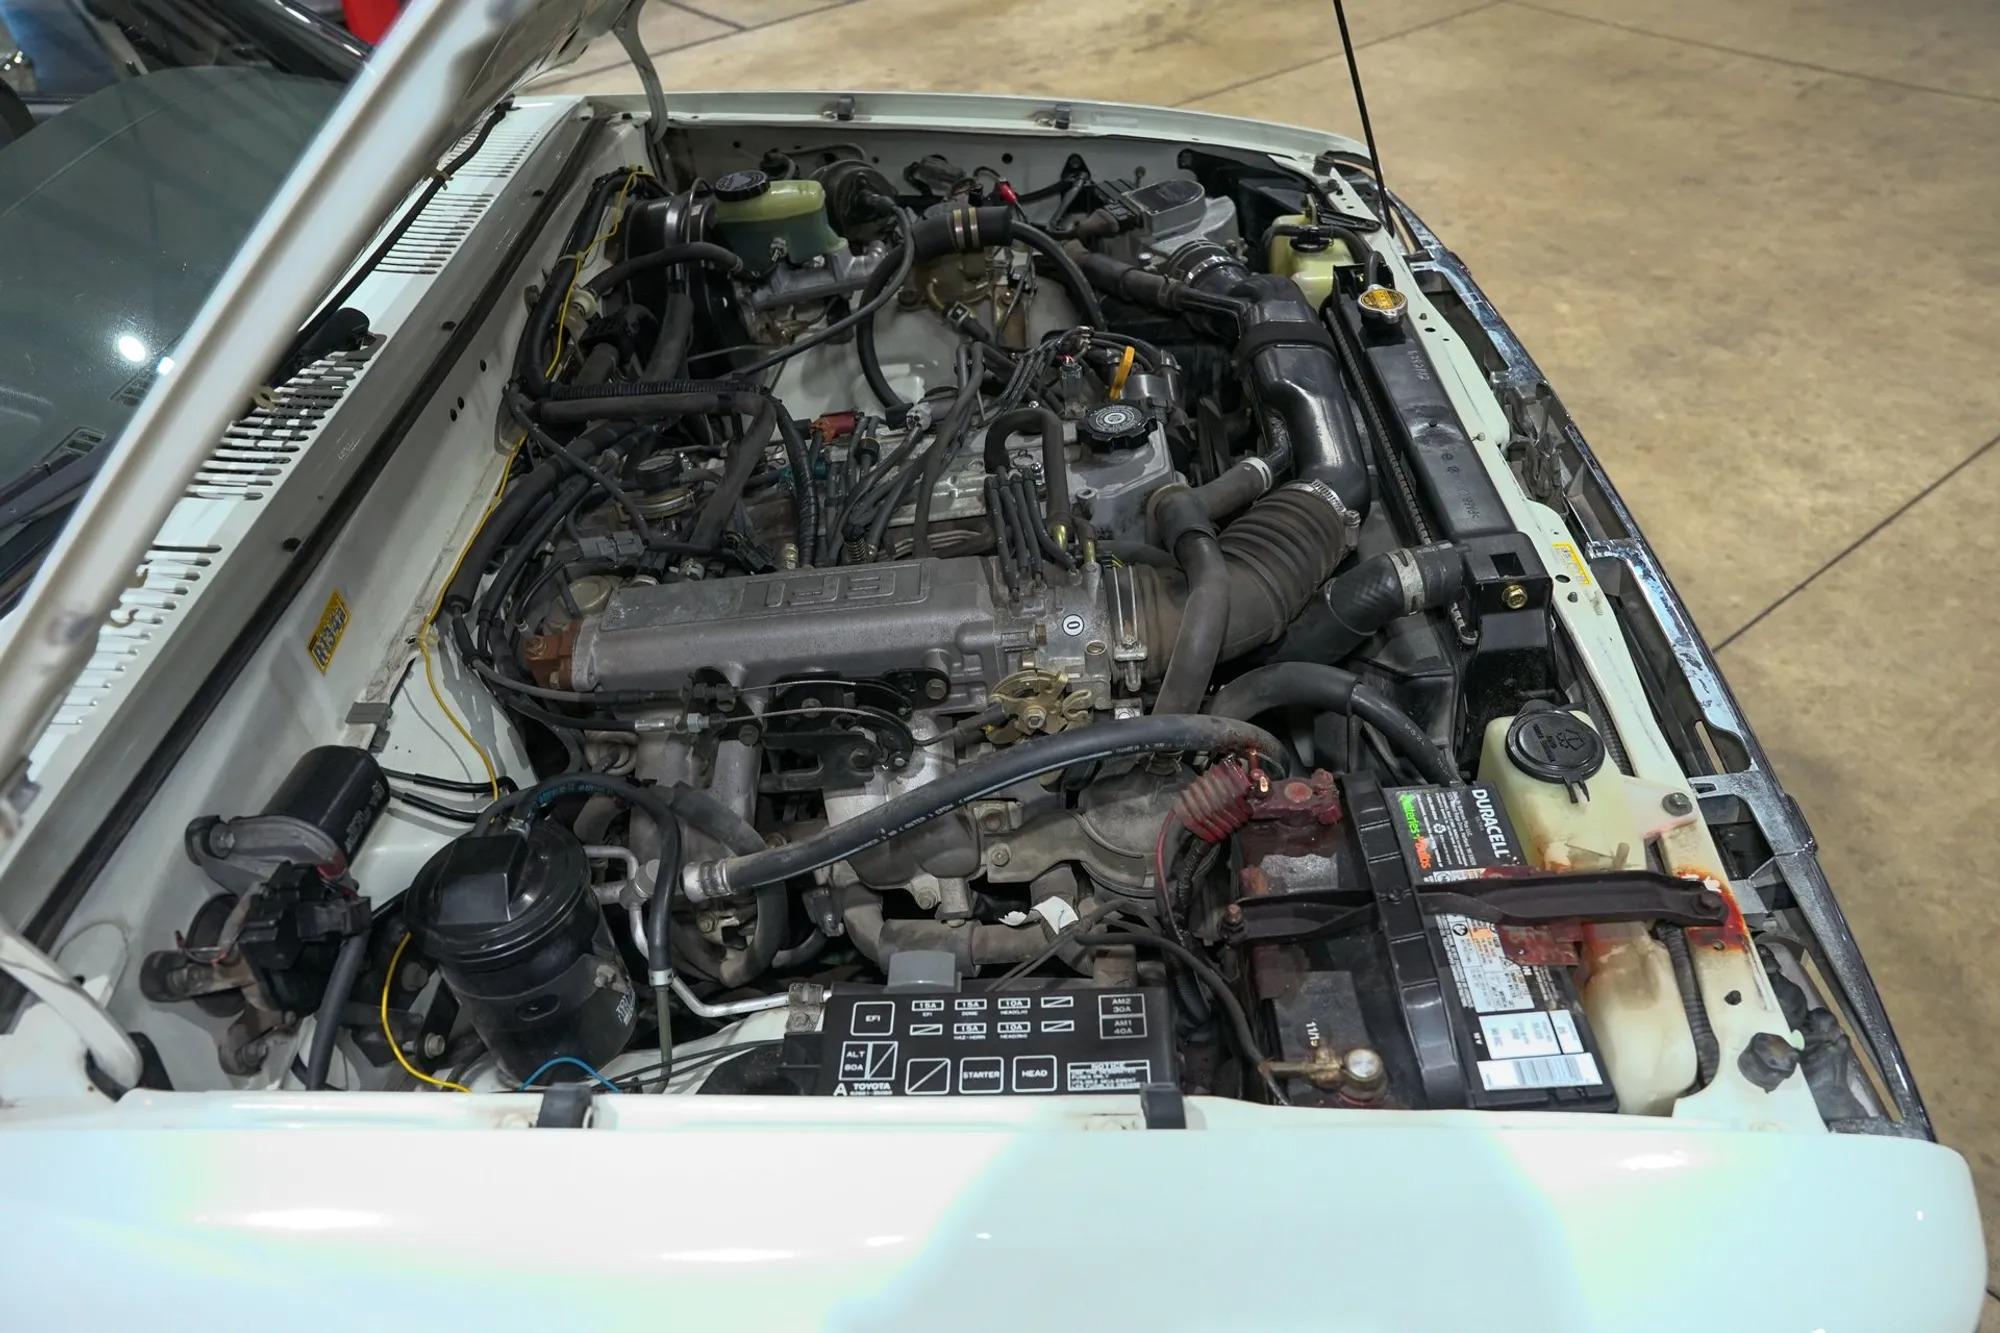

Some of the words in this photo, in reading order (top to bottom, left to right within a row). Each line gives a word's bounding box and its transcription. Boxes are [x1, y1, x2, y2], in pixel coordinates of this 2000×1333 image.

[1472, 789, 1510, 858] DURACELL
[963, 1071, 1001, 1079] STARTER
[833, 1083, 848, 1096] A
